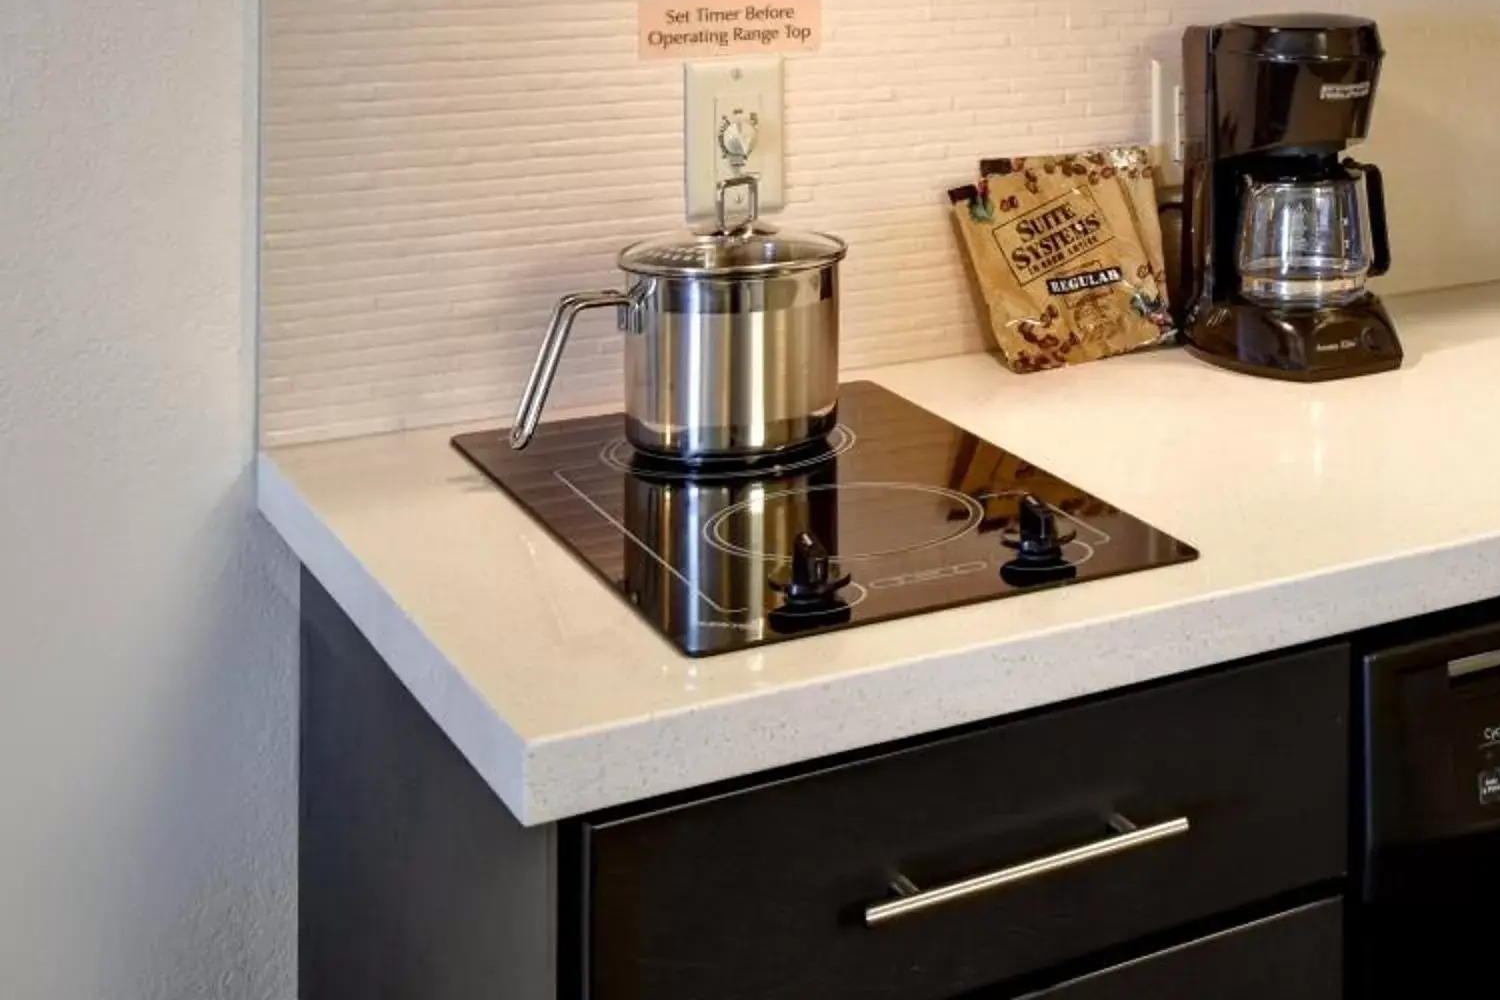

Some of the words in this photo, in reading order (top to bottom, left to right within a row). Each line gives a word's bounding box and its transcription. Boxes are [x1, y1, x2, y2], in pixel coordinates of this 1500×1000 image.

[665, 8, 690, 25] Set
[696, 7, 740, 23] Timer
[745, 4, 795, 21] Before
[648, 29, 729, 50] Operating
[733, 26, 779, 45] Range
[784, 24, 812, 42] Top
[1015, 201, 1076, 243] SUITE
[1050, 268, 1120, 293] REGULAR
